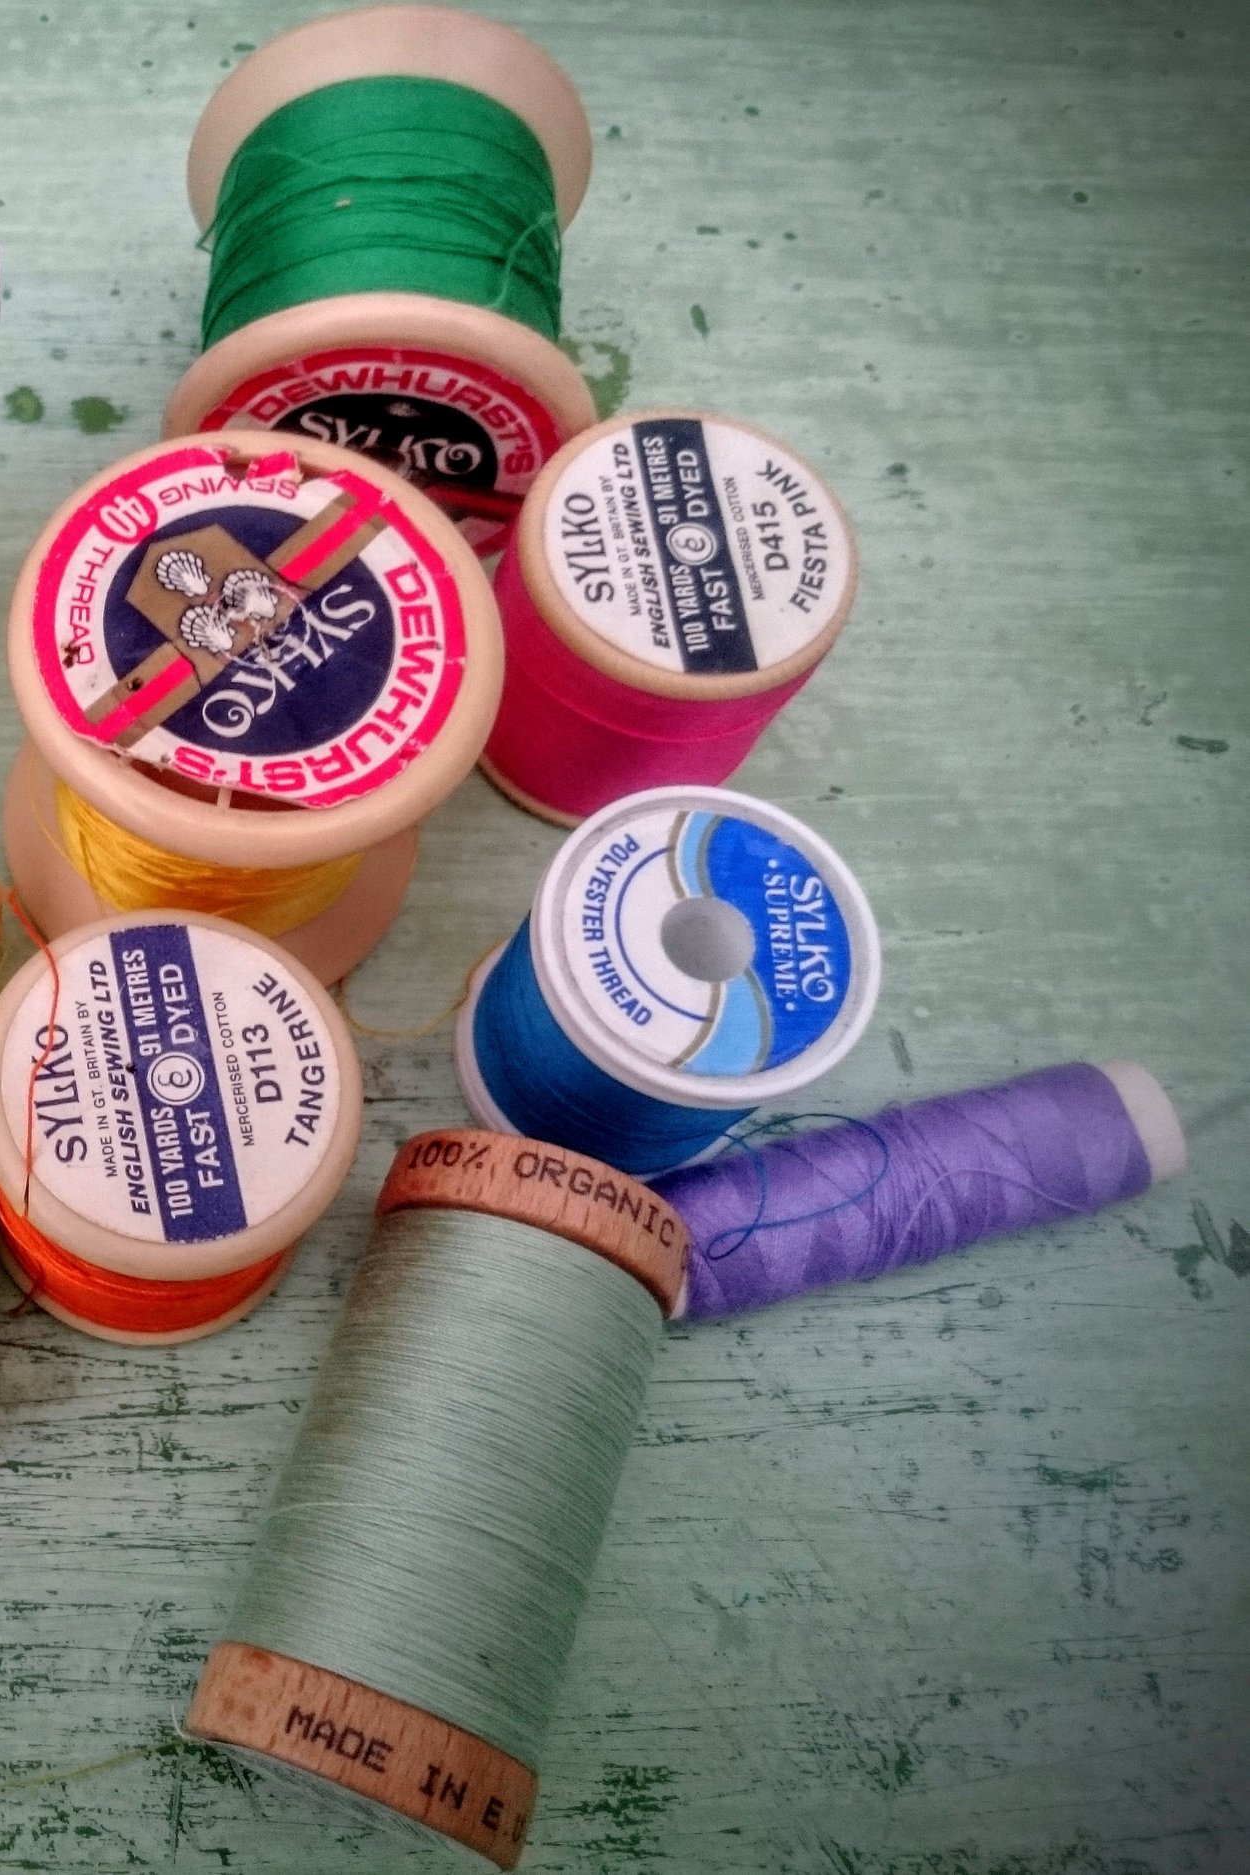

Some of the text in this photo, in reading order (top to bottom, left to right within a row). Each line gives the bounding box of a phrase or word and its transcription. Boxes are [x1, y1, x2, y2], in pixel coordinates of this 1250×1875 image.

[248, 367, 534, 475] DEWHURST'S
[599, 475, 613, 491] BY
[99, 496, 152, 539] 40
[561, 493, 614, 602] SYLKO
[604, 492, 626, 541] BRITAIN
[613, 443, 670, 649] ENGLISH SEWING LTD
[621, 567, 633, 579] IN
[642, 437, 710, 651] 100 YARDS 91 METRES
[677, 450, 736, 630] FAST DYED
[722, 476, 766, 601] MERCERISED COTTON
[751, 501, 790, 572] D415
[754, 459, 828, 614] FIESTA PINK
[67, 543, 115, 667] THREAD
[201, 584, 376, 739] SYLKO
[624, 583, 642, 617] MADE
[172, 559, 446, 794] DEWHURST'S
[582, 833, 653, 1027] POLYESTER THREAD
[762, 873, 799, 1000] SUPREME
[789, 875, 834, 1003] SYLKO
[75, 1001, 91, 1019] BY
[80, 1023, 101, 1080] BRITAIN
[212, 991, 255, 1147] MERCERISED COTTON
[241, 1024, 284, 1104] D113
[251, 971, 326, 1149] TANGERINE
[31, 1023, 88, 1164] SYLKO
[89, 960, 152, 1216] ENGLISH SEWING LTD
[97, 1115, 109, 1131] IN
[122, 948, 194, 1220] 100 YARDS 91 METRES
[159, 963, 224, 1191] FAST DYED
[97, 1136, 118, 1178] MADE
[407, 1140, 675, 1248] 100% ORGANIC
[284, 1704, 394, 1773] MADE
[418, 1762, 469, 1810] IN
